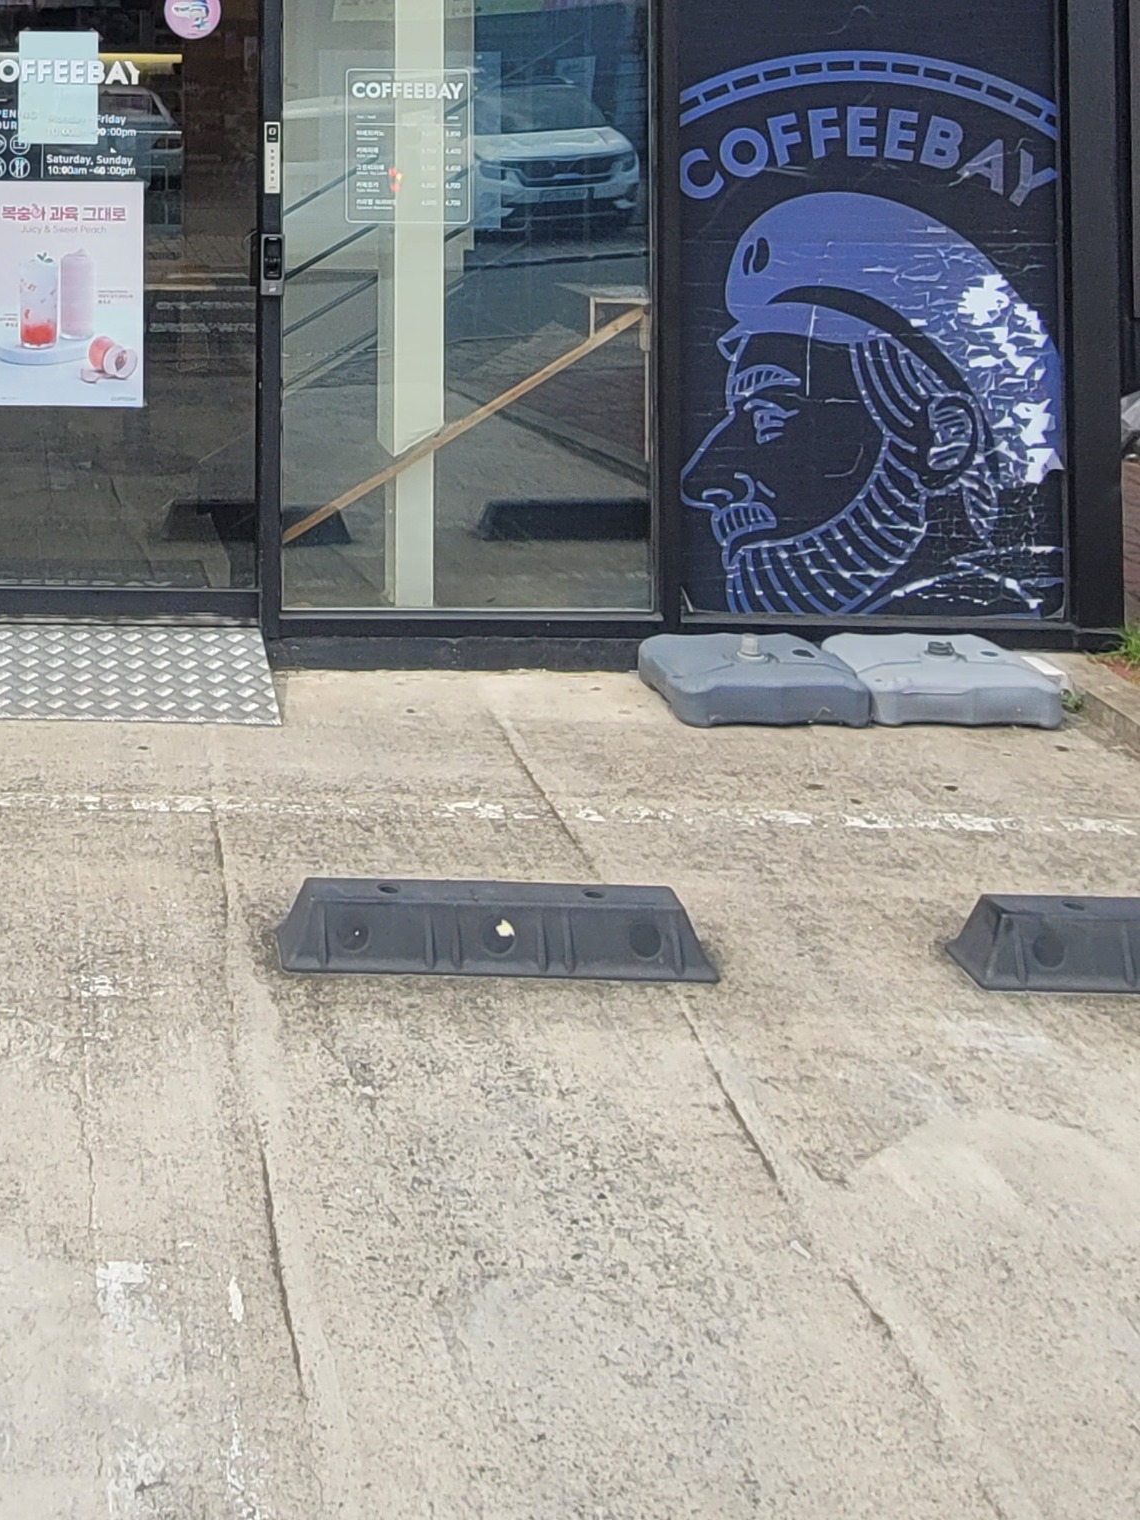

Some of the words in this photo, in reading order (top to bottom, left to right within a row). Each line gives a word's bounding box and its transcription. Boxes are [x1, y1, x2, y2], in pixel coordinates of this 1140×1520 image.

[351, 81, 464, 100] COFFEEBAY
[46, 153, 94, 165] Saturday,
[96, 154, 134, 166] Sunday
[679, 105, 1059, 207] COFFEEBAY
[1, 203, 47, 222] 복숭아
[49, 206, 80, 222] 과육
[81, 207, 127, 222] 그대로
[52, 224, 79, 234] Sweet
[80, 224, 107, 234] Peach
